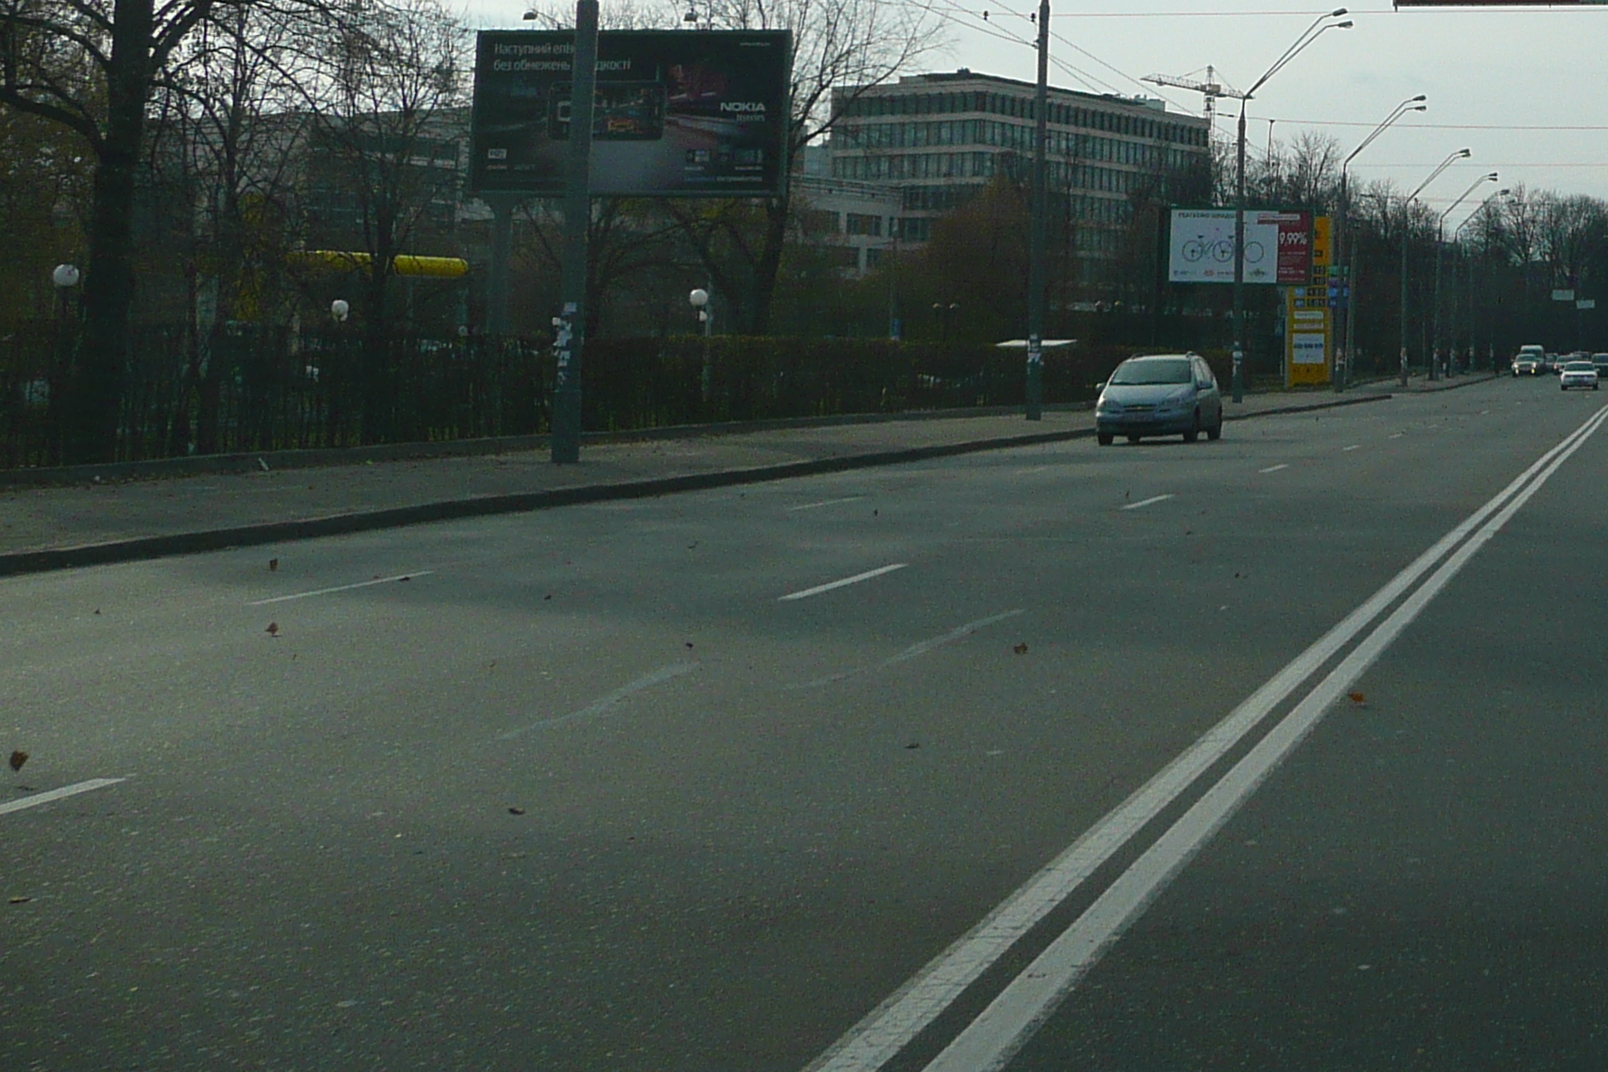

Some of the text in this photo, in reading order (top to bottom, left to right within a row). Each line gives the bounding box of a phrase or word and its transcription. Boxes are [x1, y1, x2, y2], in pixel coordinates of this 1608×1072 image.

[494, 42, 575, 56] Наступний епі
[493, 58, 632, 71] без обмежень дкості
[720, 102, 766, 112] NOKIA
[1279, 231, 1308, 247] 9,99%
